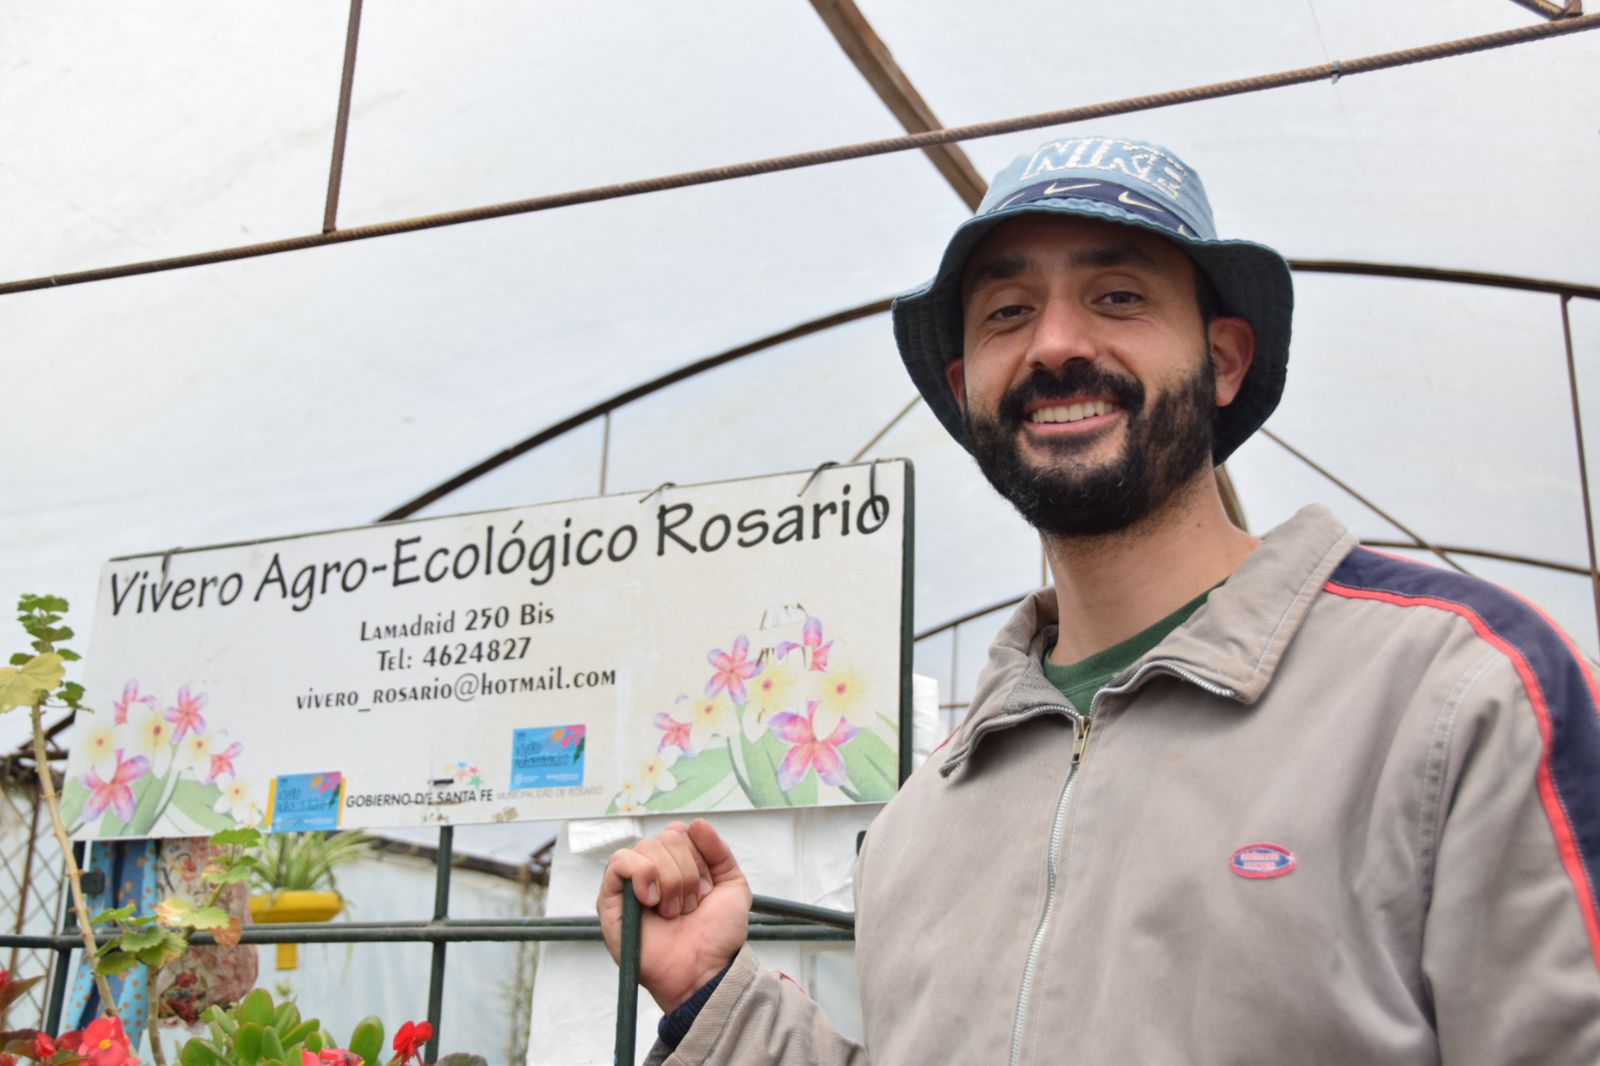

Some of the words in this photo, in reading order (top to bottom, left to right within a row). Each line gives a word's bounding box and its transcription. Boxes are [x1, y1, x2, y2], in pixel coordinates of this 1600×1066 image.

[1020, 137, 1188, 200] NIKE
[109, 569, 244, 616] Vivero
[253, 517, 639, 613] Agro-Ecológico
[656, 484, 891, 557] Rosario
[360, 610, 456, 642] Lamadrid
[464, 605, 510, 632] 250
[519, 602, 555, 626] Bis
[376, 647, 413, 672] Tel:
[422, 636, 532, 668] 4624827
[346, 792, 410, 808] GOBIERNO
[415, 791, 433, 806] DE
[436, 789, 476, 804] SANTA
[480, 788, 493, 802] FE
